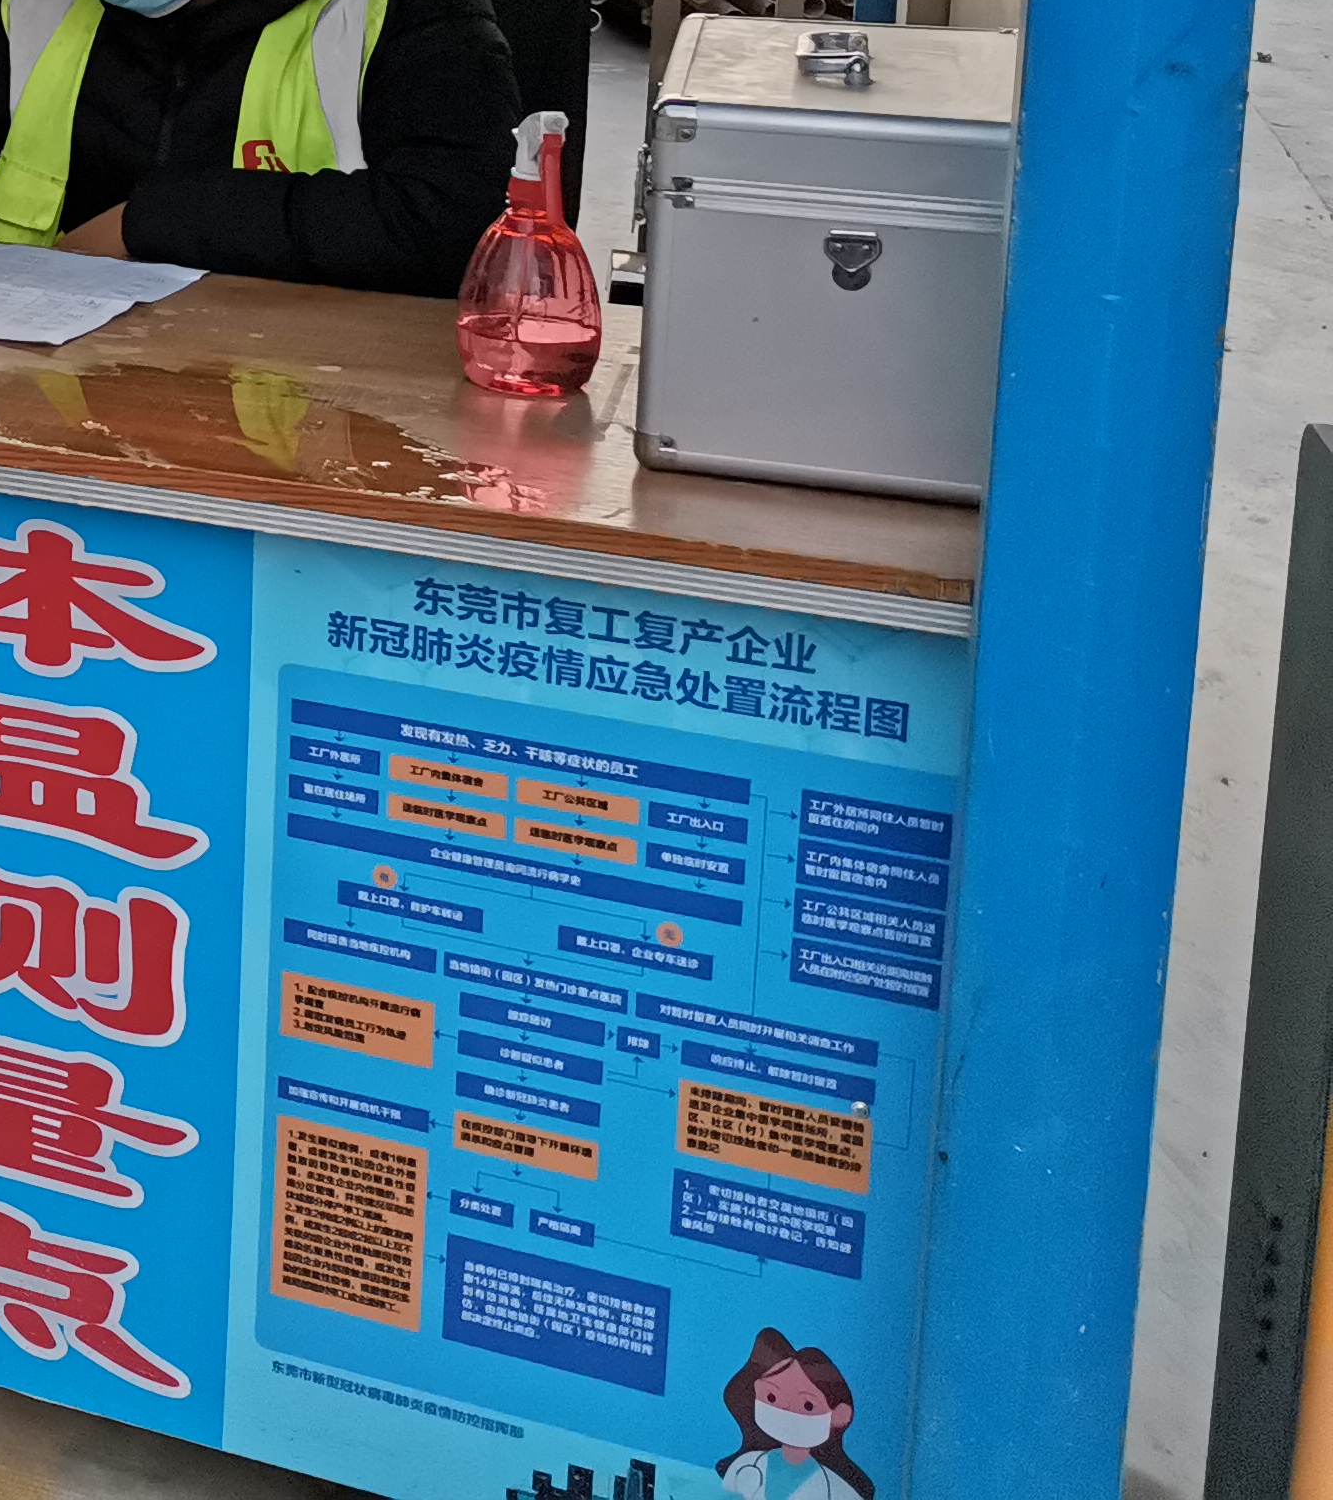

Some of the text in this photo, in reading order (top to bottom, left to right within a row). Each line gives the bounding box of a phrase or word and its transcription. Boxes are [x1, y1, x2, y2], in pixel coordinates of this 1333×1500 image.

[413, 576, 818, 676] 东莞市复工复产企业
[327, 610, 911, 743] 新冠肺炎疫情应急处置流程图
[542, 789, 609, 812] 工厂公共区域
[666, 812, 724, 833] 工厂出入口
